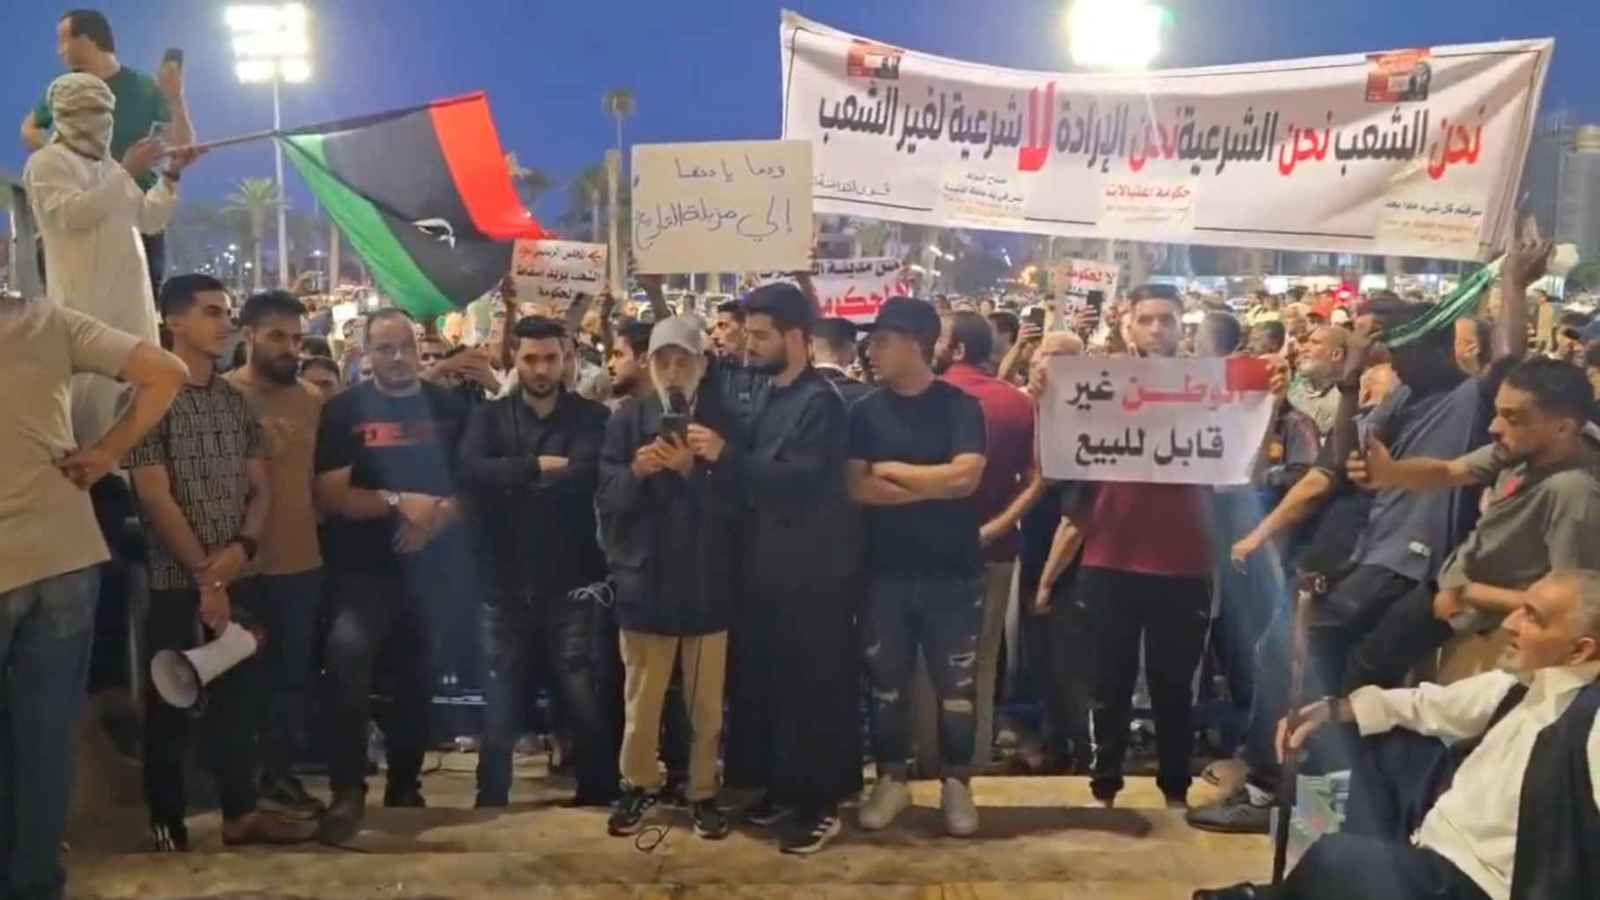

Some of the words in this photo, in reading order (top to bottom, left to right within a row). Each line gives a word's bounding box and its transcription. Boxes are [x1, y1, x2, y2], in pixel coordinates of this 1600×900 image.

[819, 80, 899, 144] الشعب
[896, 88, 947, 154] لغير
[949, 91, 1023, 160] شرعية
[1017, 81, 1057, 171] لا
[1055, 100, 1130, 173] الإرادة
[1177, 105, 1279, 176] الشرعية
[1278, 110, 1334, 176] نحن
[1334, 106, 1429, 177] الشعب
[1425, 106, 1487, 181] نحن
[1067, 371, 1116, 411] غير
[1122, 375, 1244, 411] وطن
[1074, 427, 1147, 468] للبيع
[1153, 425, 1226, 467] قابل
